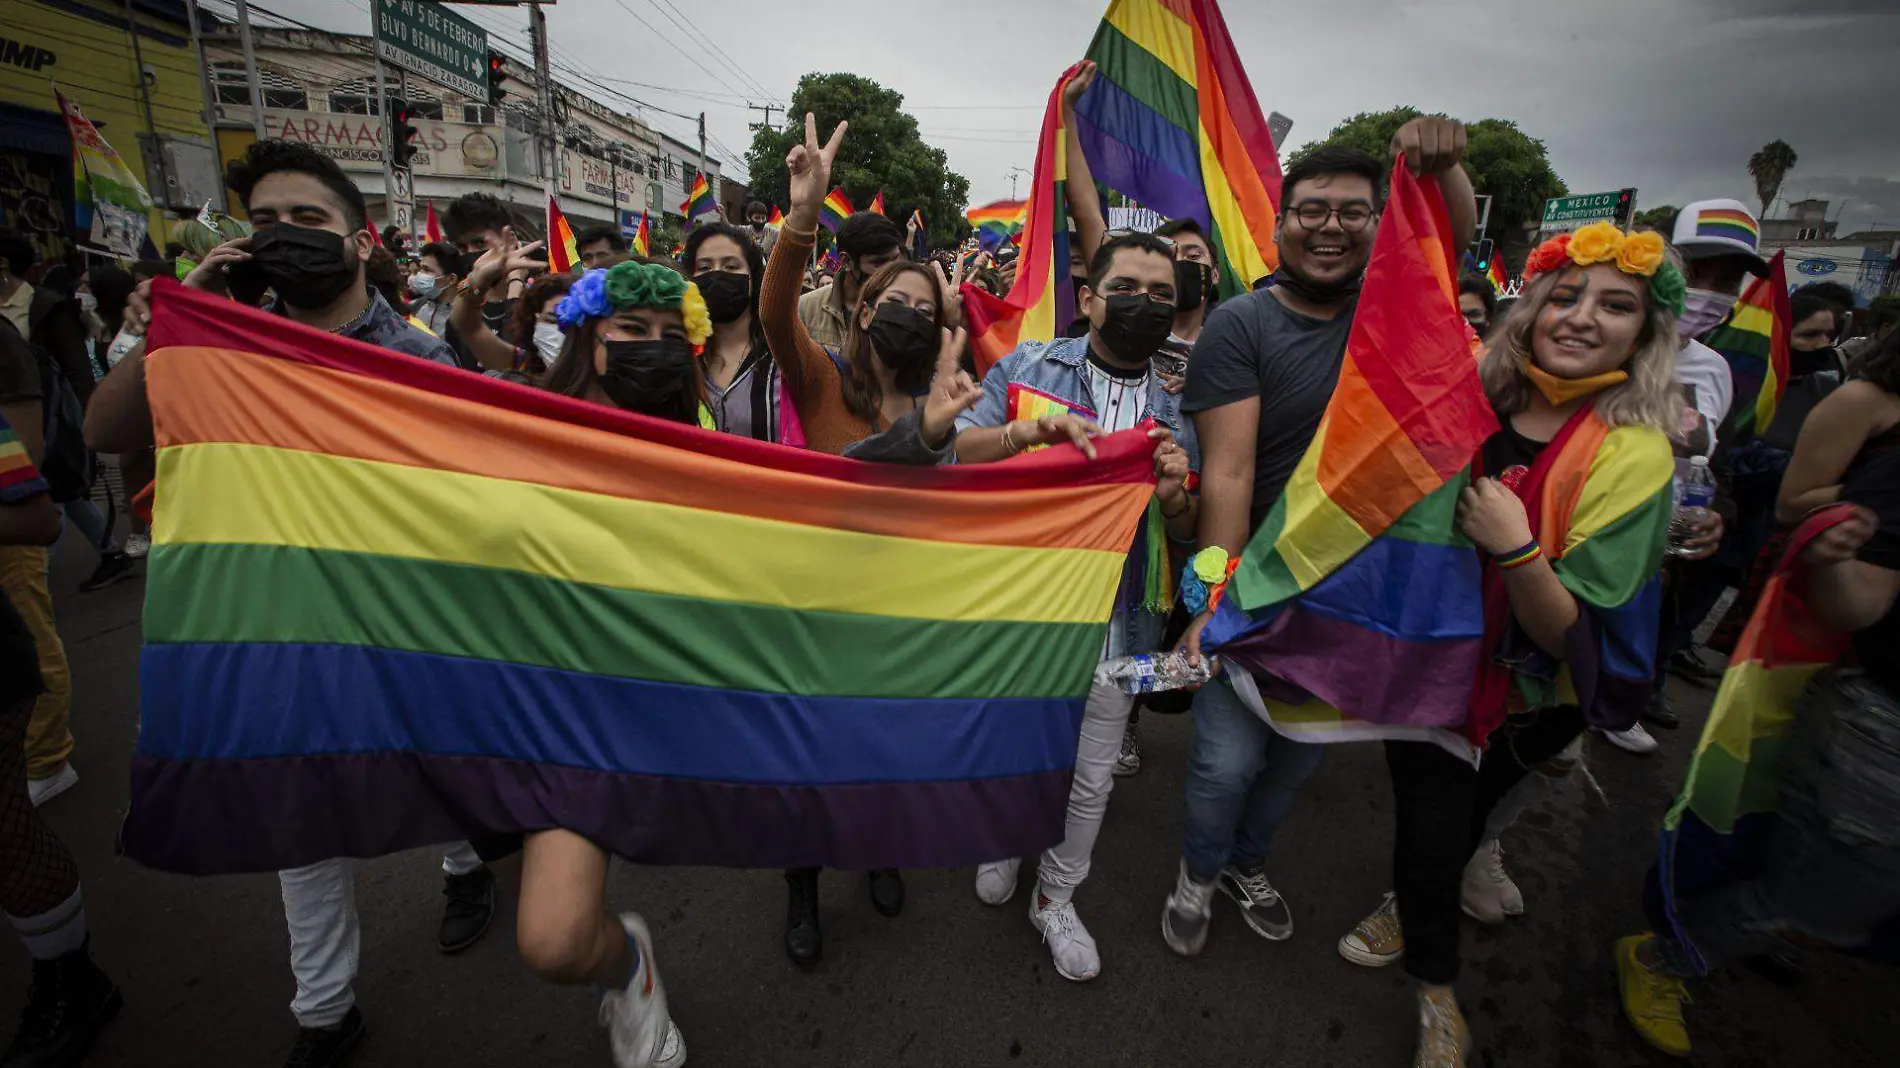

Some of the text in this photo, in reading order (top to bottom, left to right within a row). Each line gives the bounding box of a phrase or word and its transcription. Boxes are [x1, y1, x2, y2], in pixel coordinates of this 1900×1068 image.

[381, 12, 408, 42] BLVD
[412, 28, 460, 67] BERNARDO
[401, 0, 485, 54] AV 5 DE FEBRERO
[385, 44, 485, 99] AV IGNACIO ZARAGOZA
[263, 114, 448, 153] FARMAAS
[313, 146, 430, 164] ANCISCO SIS
[1546, 212, 1556, 221] AV
[1567, 195, 1610, 209] MEXICO
